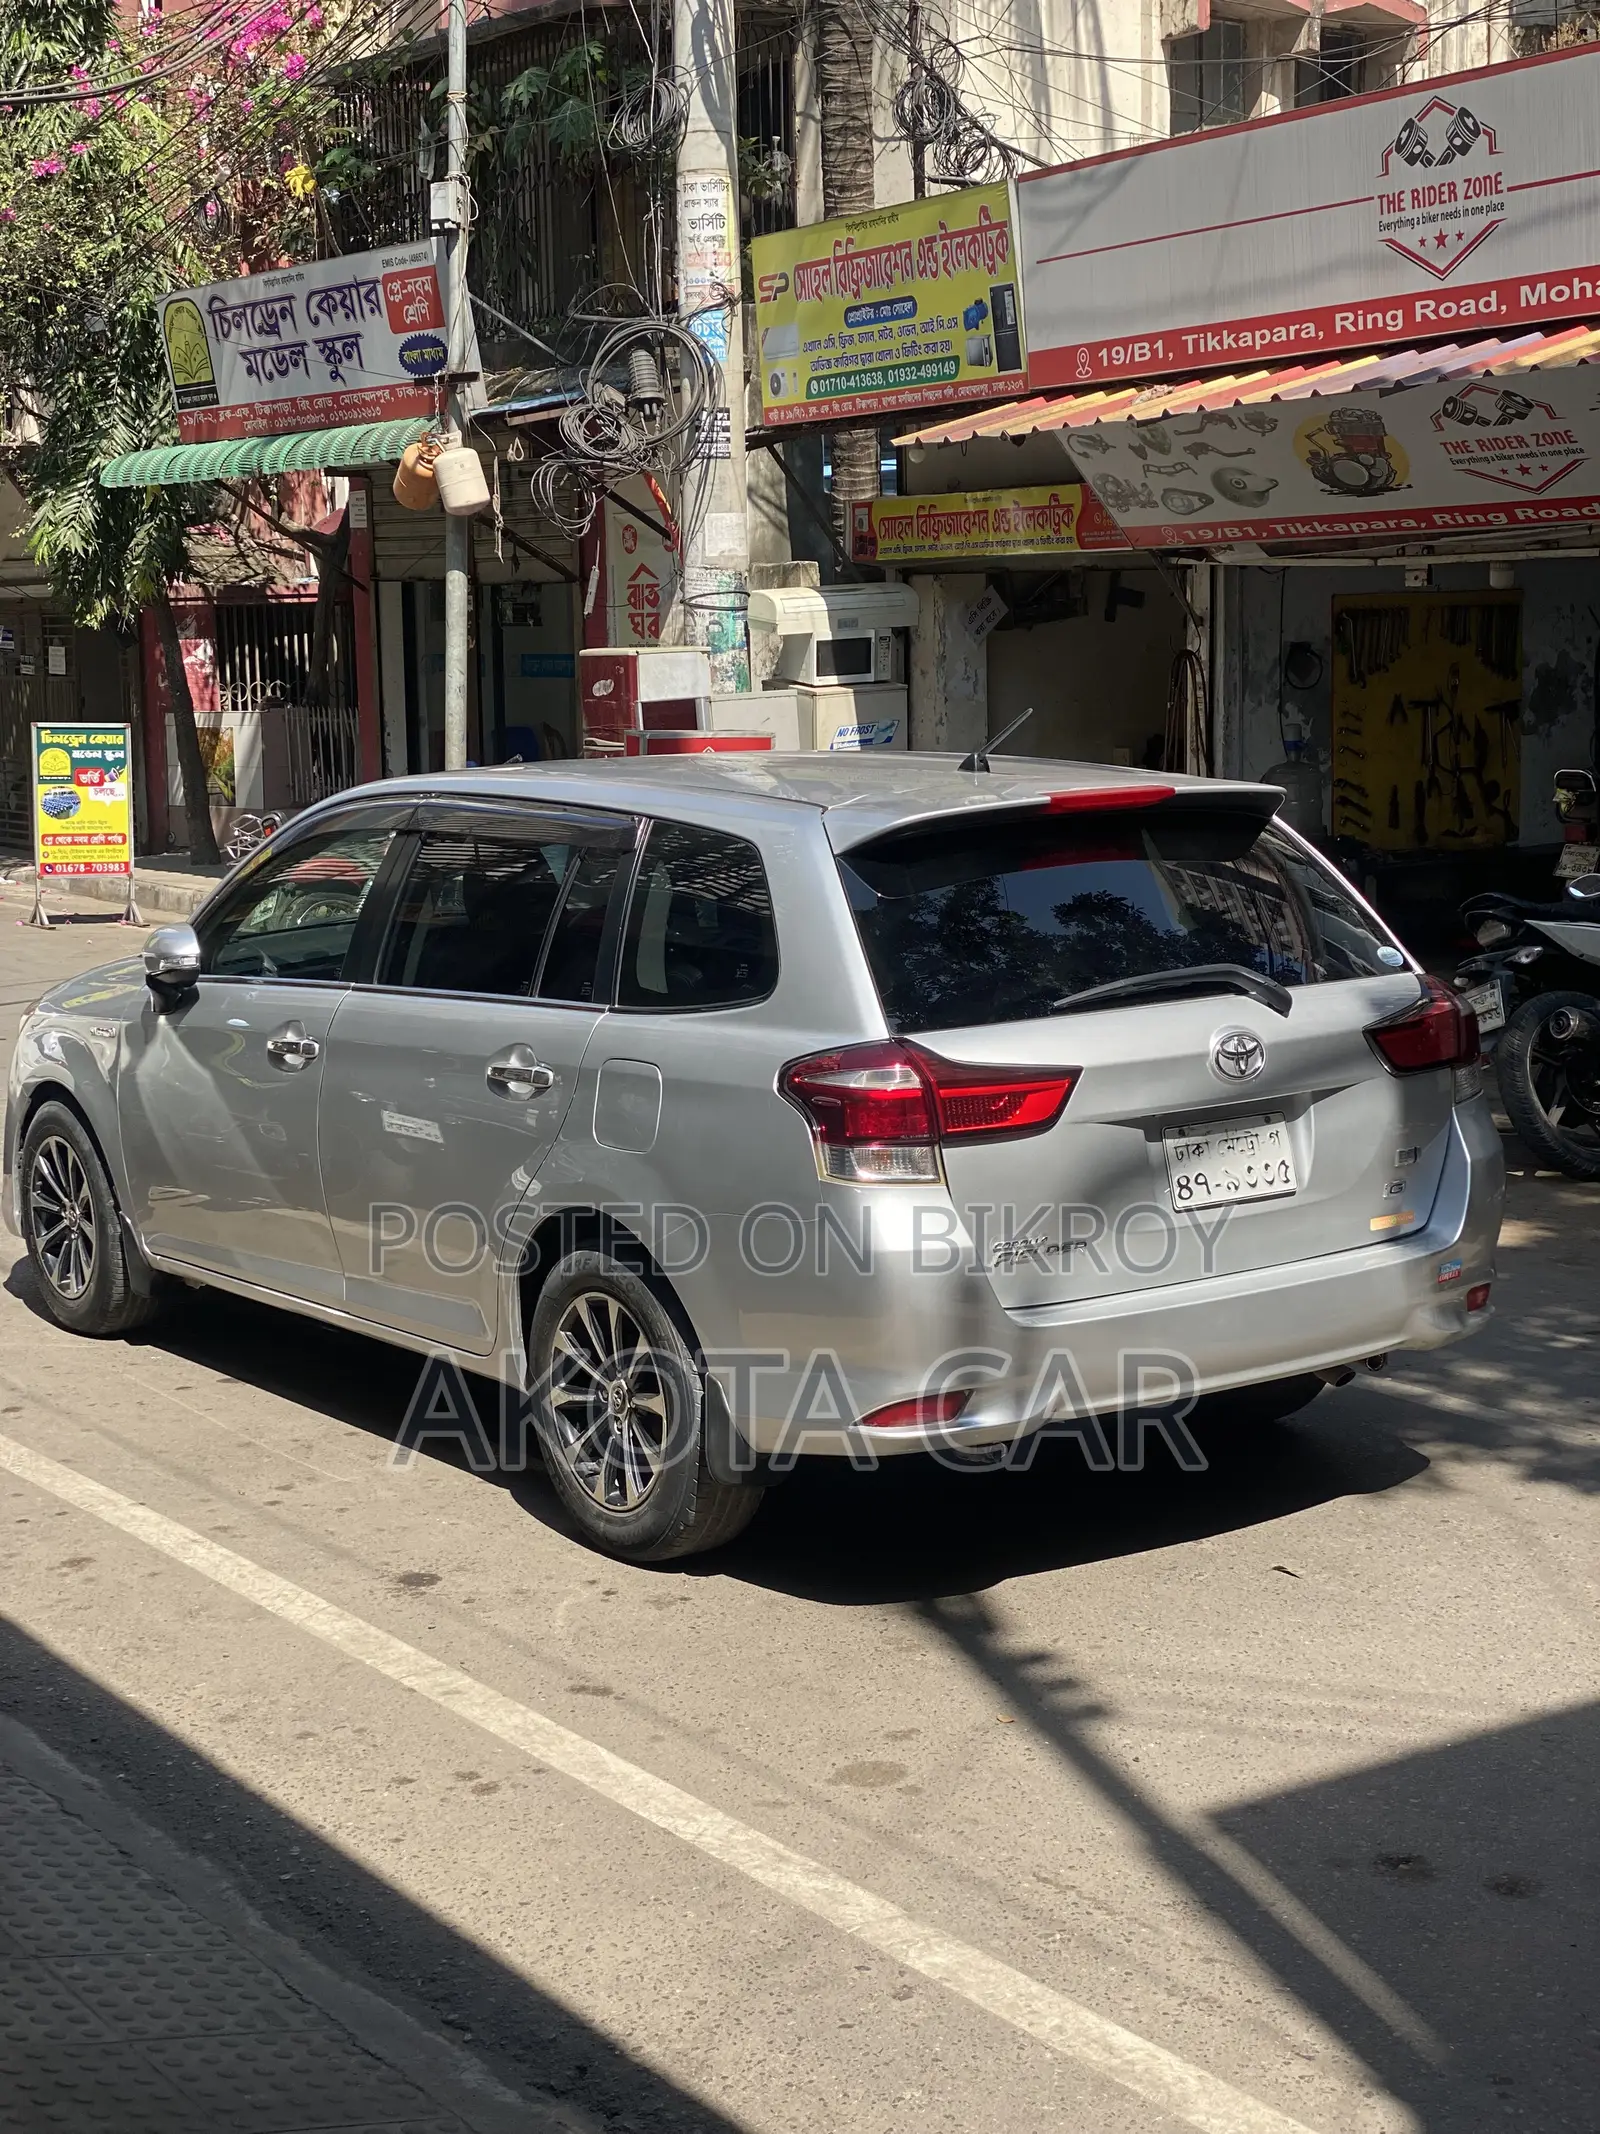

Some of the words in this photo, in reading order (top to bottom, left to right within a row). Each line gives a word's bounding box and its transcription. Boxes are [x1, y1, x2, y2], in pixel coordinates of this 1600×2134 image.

[1377, 190, 1406, 216] THE
[1410, 180, 1458, 210] RIDER
[1463, 171, 1504, 200] ZONE
[1378, 216, 1415, 233] Everything
[1416, 217, 1421, 226] a
[1421, 211, 1439, 225] biker
[1440, 206, 1462, 222] needs
[1462, 204, 1470, 218] in
[1470, 205, 1485, 217] one
[1485, 200, 1505, 217] place
[381, 257, 395, 268] EMIS
[793, 256, 833, 304] সোহেল
[832, 237, 916, 300] রিফ্রিজারেশন
[916, 234, 941, 281] এন্ড
[387, 275, 433, 303] প্লে-নবম
[206, 293, 299, 345] চিলড্রেন
[306, 274, 385, 331] কেয়ার
[403, 296, 430, 325] শ্রেণি
[892, 301, 914, 316] সোহেল
[1098, 337, 1175, 368] 19/B1,
[1181, 320, 1325, 355] Tikkapara,
[1333, 308, 1404, 333] Ring
[1414, 289, 1508, 324] Road,
[238, 339, 311, 387] মডেল
[312, 331, 365, 388] স্কুল
[401, 347, 423, 365] বাংলা
[422, 346, 445, 362] মাধ্যম
[833, 351, 859, 368] কারিগর
[923, 340, 939, 354] করা
[819, 370, 886, 394] 01710-413638,
[887, 360, 956, 384] 01932-499149
[297, 397, 310, 412] রিং
[313, 395, 337, 409] রোড,
[1440, 438, 1472, 457] THE
[1474, 434, 1530, 453] RIDER
[1531, 429, 1579, 448] ZONE
[1449, 452, 1490, 466] Everything
[1495, 452, 1515, 462] biker
[1515, 449, 1539, 460] needs
[1540, 449, 1547, 458] in
[1548, 449, 1563, 458] one
[1564, 446, 1585, 458] place
[878, 514, 914, 543] সোহেল
[1184, 525, 1268, 542] 19/B1,
[1268, 516, 1427, 537] Tikkapara,
[1433, 510, 1508, 527] Ring
[40, 729, 87, 748] চিলড্রেন
[89, 734, 125, 745] কেয়ার
[836, 727, 850, 738] NO
[850, 724, 877, 736] FROST
[71, 749, 102, 759] মডেল
[103, 749, 125, 762] স্কুল
[78, 769, 101, 785] ভর্তি
[55, 863, 126, 873] 01678-703983
[1173, 1138, 1212, 1163] ঢাকা
